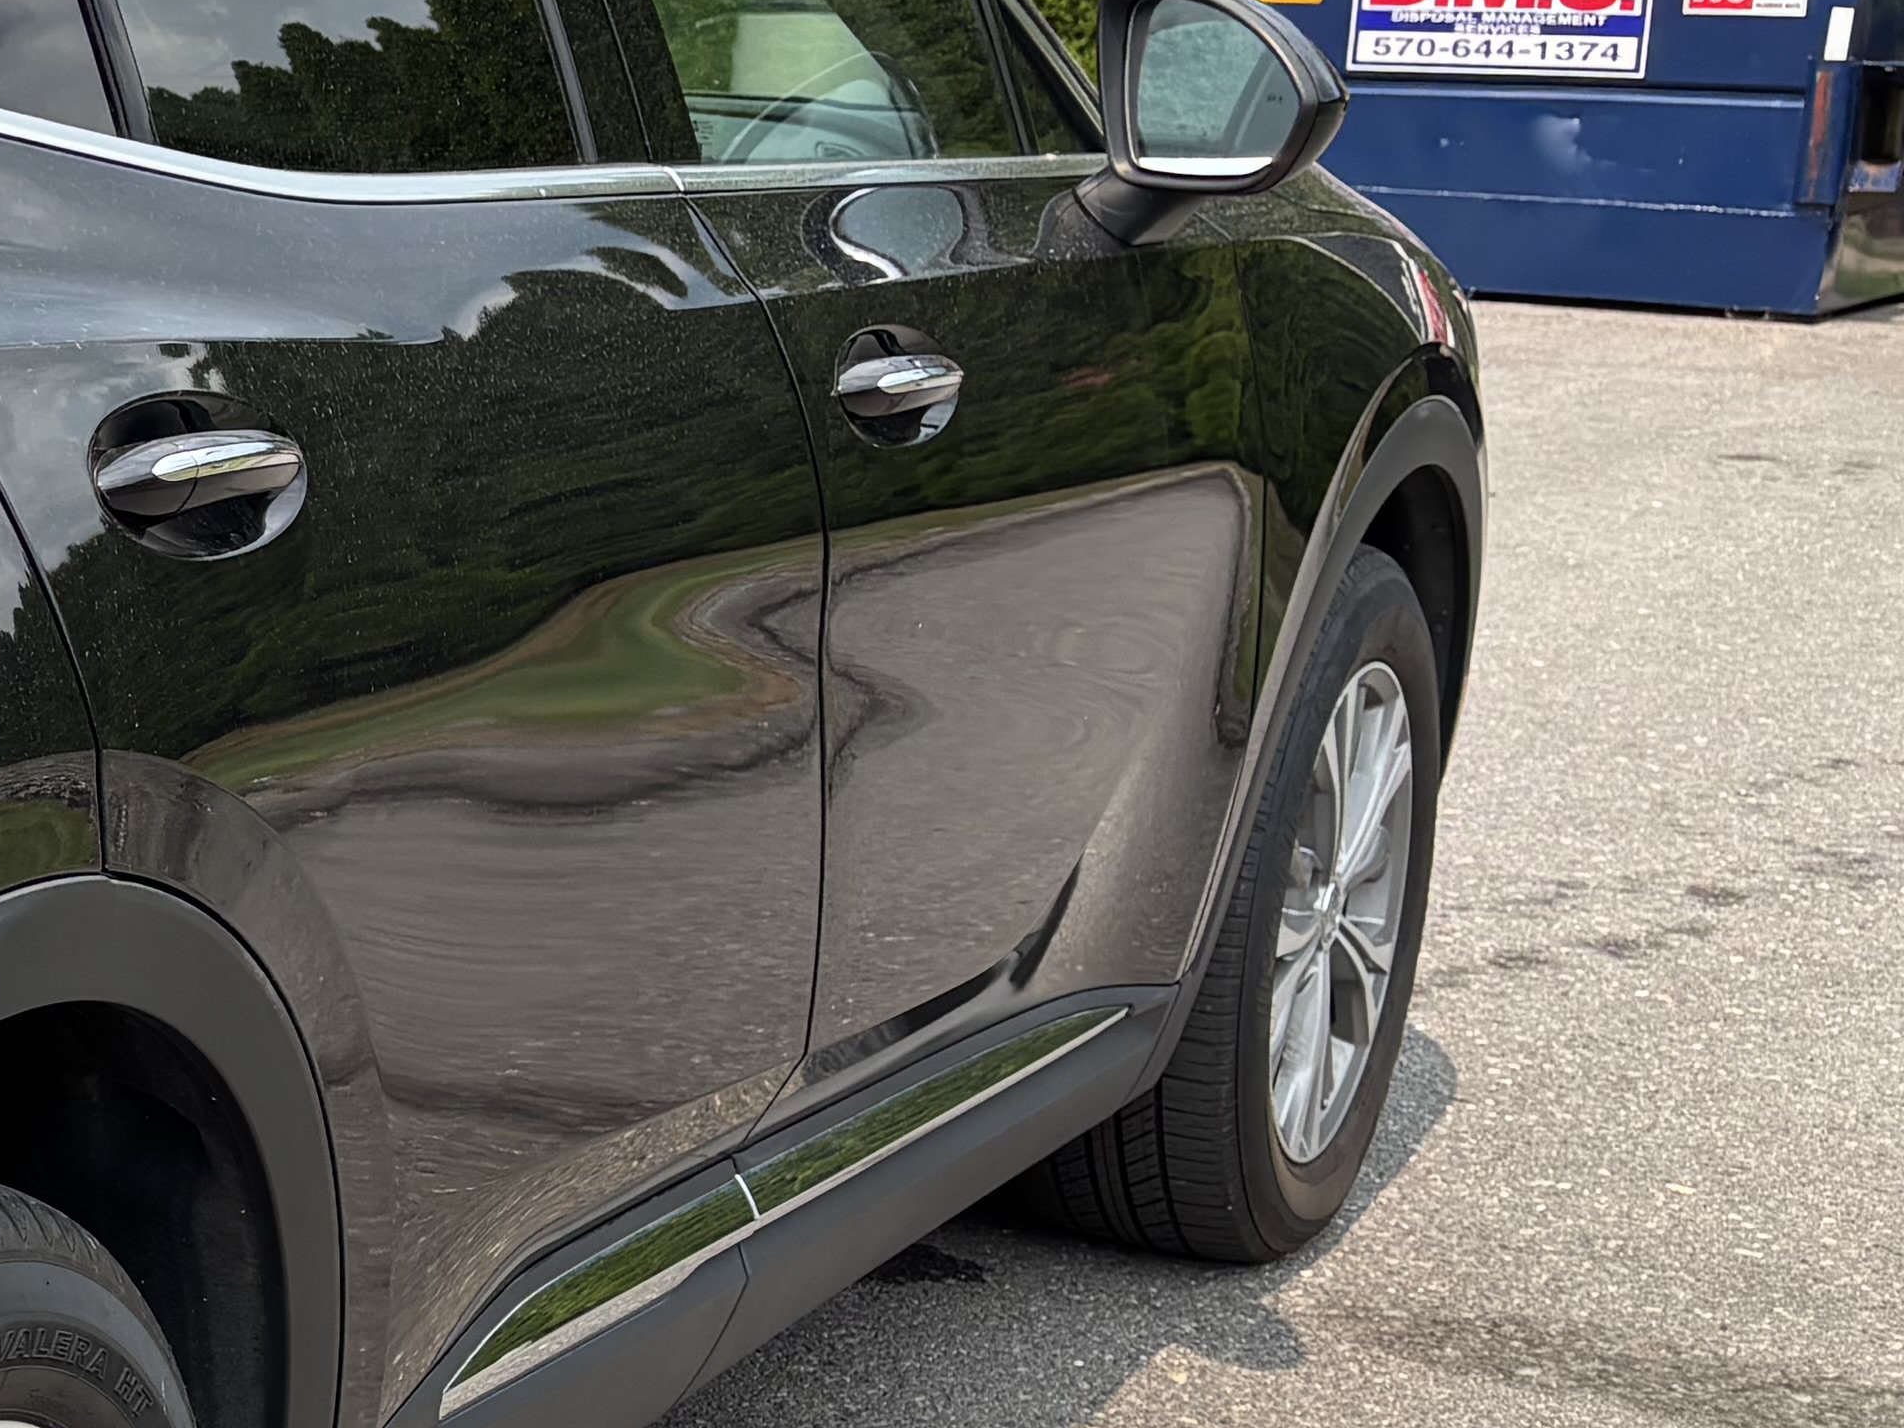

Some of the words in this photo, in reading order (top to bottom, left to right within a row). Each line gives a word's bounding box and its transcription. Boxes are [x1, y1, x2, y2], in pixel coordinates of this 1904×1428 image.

[1390, 10, 1478, 25] DISPOSAL
[1481, 11, 1608, 28] MANAGEMENT
[1453, 23, 1542, 36] SERVICES
[1372, 36, 1620, 62] 570-644-1374
[113, 1366, 155, 1418] HT
